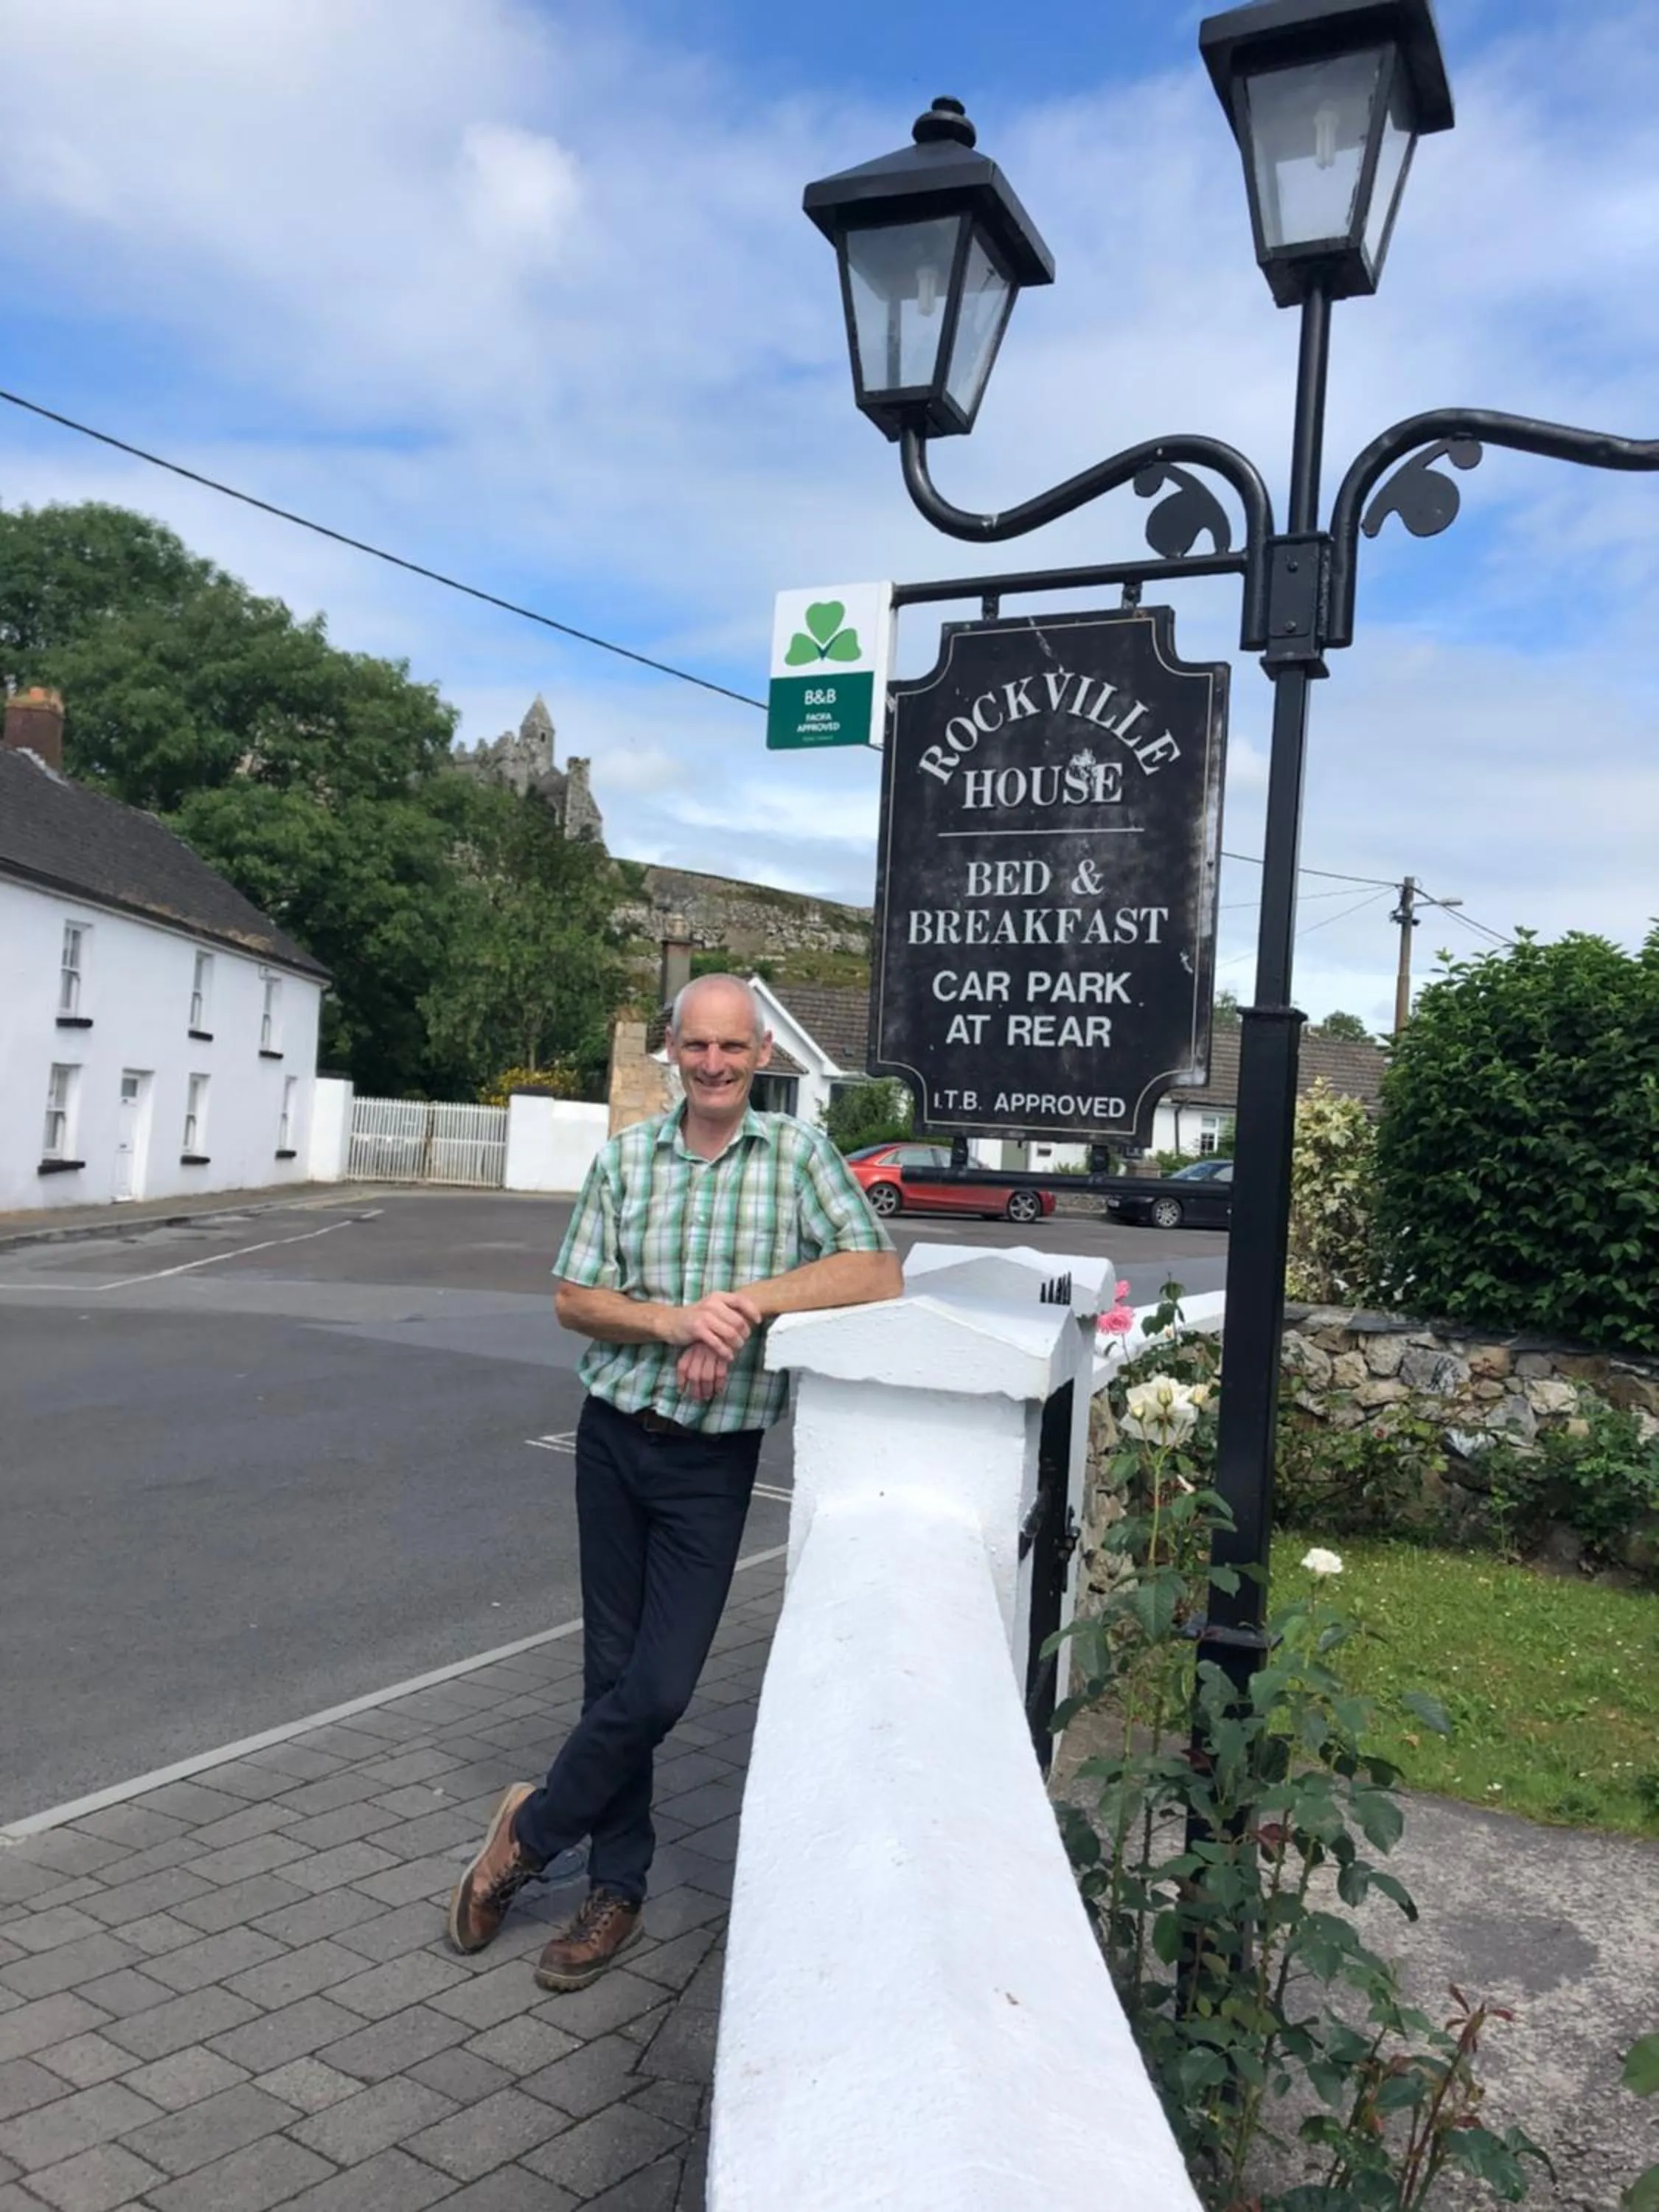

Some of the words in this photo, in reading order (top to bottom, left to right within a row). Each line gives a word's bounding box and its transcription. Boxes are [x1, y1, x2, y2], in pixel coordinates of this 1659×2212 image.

[804, 688, 837, 705] B&B
[796, 722, 841, 732] APPROVED
[919, 672, 1181, 785] ROCKVILLE
[961, 762, 1123, 809] HOUSE
[966, 860, 1051, 897] BED
[1071, 858, 1104, 896] &
[908, 907, 1169, 946] BREAKFAST
[932, 970, 1010, 1003] CAR
[1026, 970, 1132, 1004] PARK
[945, 1015, 991, 1045] AT
[1007, 1015, 1111, 1048] REAR
[994, 1092, 1126, 1118] APPROVED
